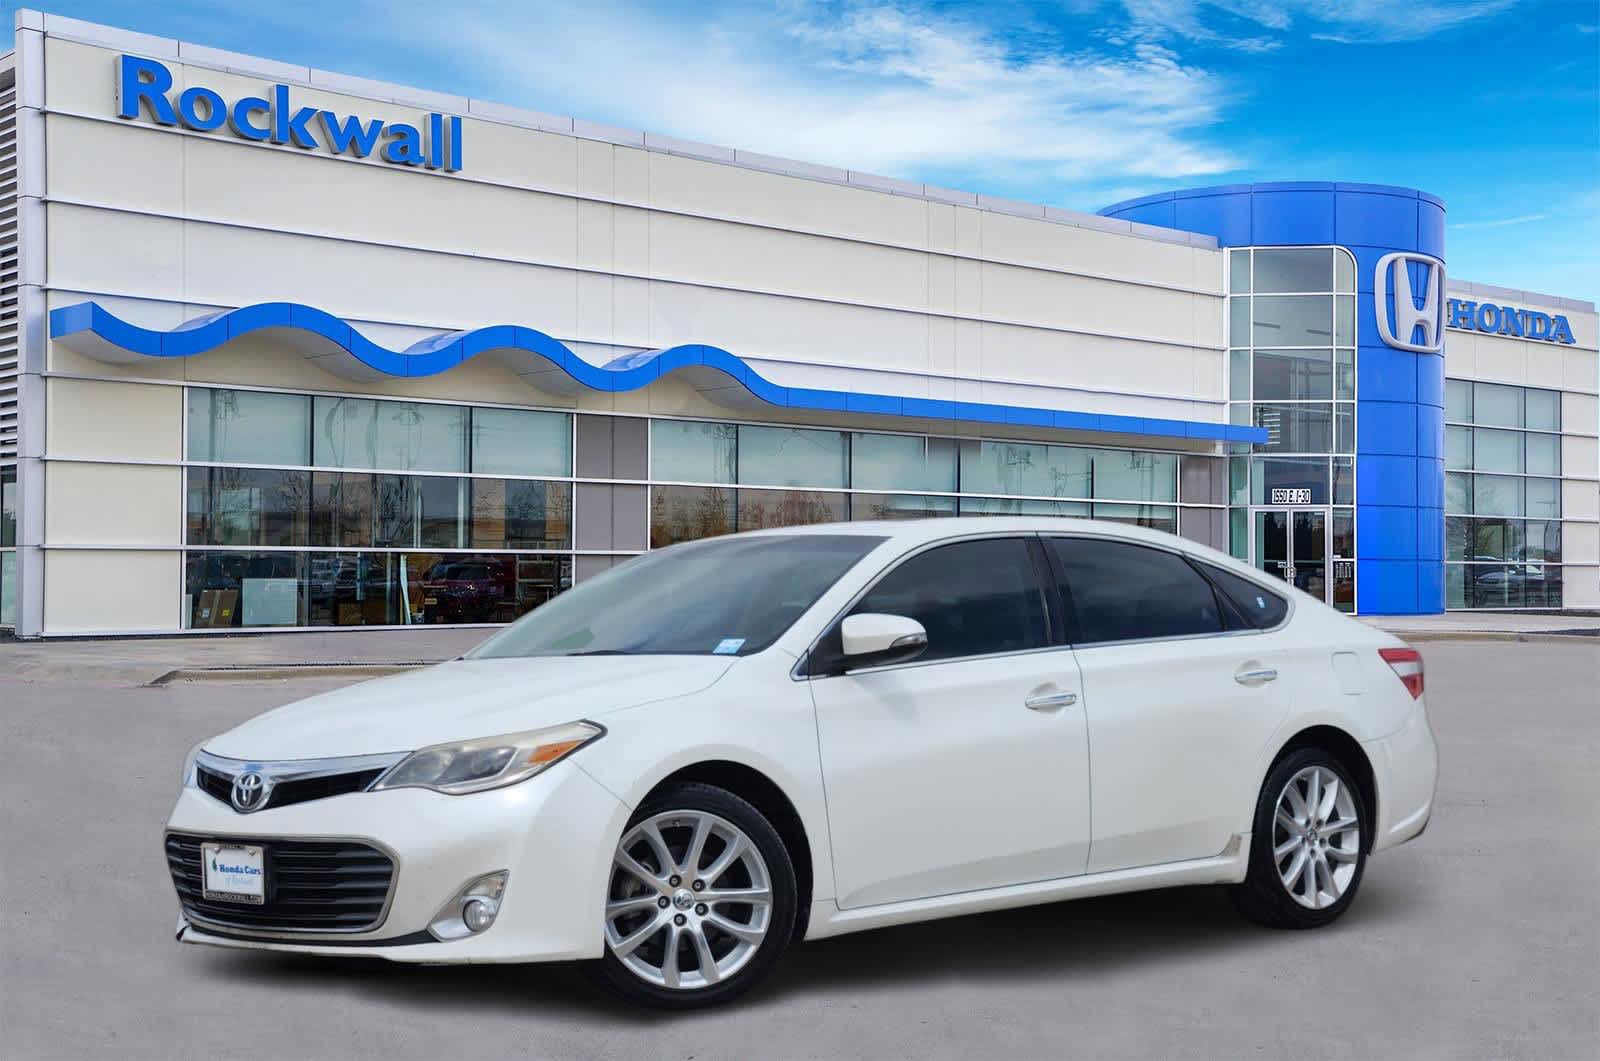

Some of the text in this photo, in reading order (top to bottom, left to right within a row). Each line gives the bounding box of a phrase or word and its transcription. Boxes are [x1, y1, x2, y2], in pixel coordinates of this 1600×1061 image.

[116, 54, 463, 172] Rockwall
[1447, 298, 1576, 345] HONDA
[219, 864, 261, 875] Honda Cars
